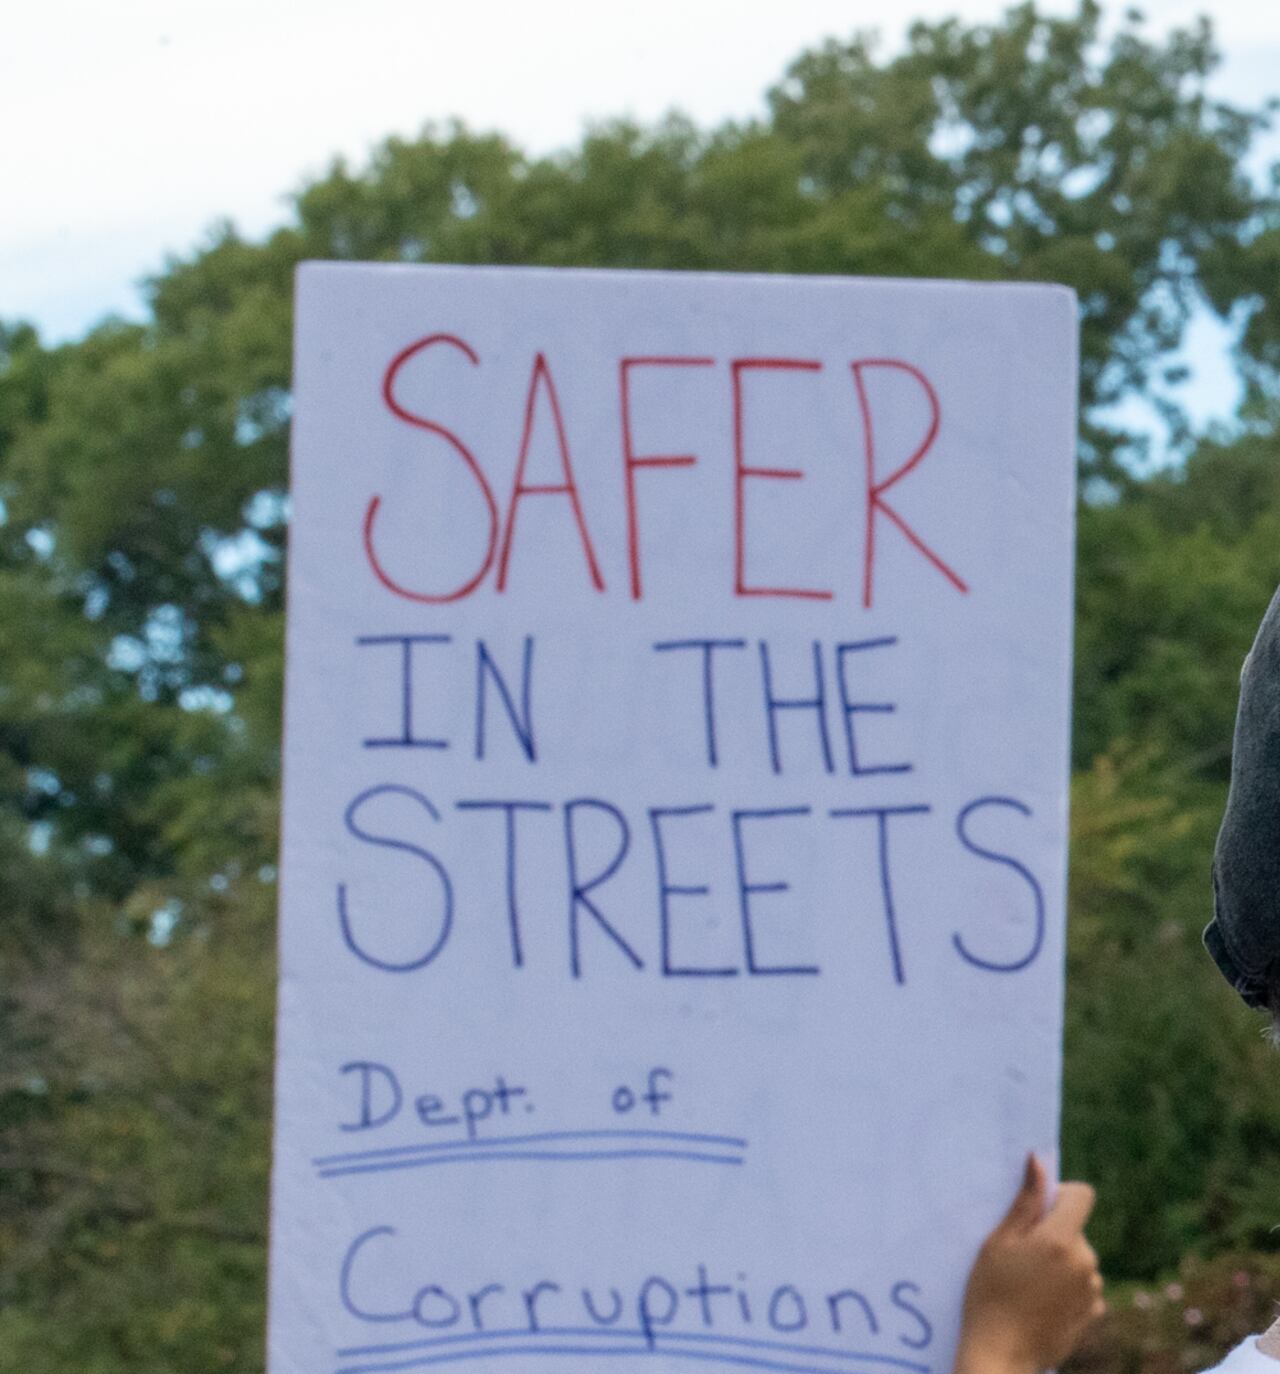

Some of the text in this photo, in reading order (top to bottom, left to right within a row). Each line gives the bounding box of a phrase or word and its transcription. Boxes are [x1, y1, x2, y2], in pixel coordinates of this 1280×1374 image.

[364, 333, 968, 607] SAFER
[355, 635, 914, 776] IN THE
[338, 783, 1046, 985] STREETS
[338, 1060, 674, 1139] Dept. of
[339, 1225, 934, 1350] Corruptions
